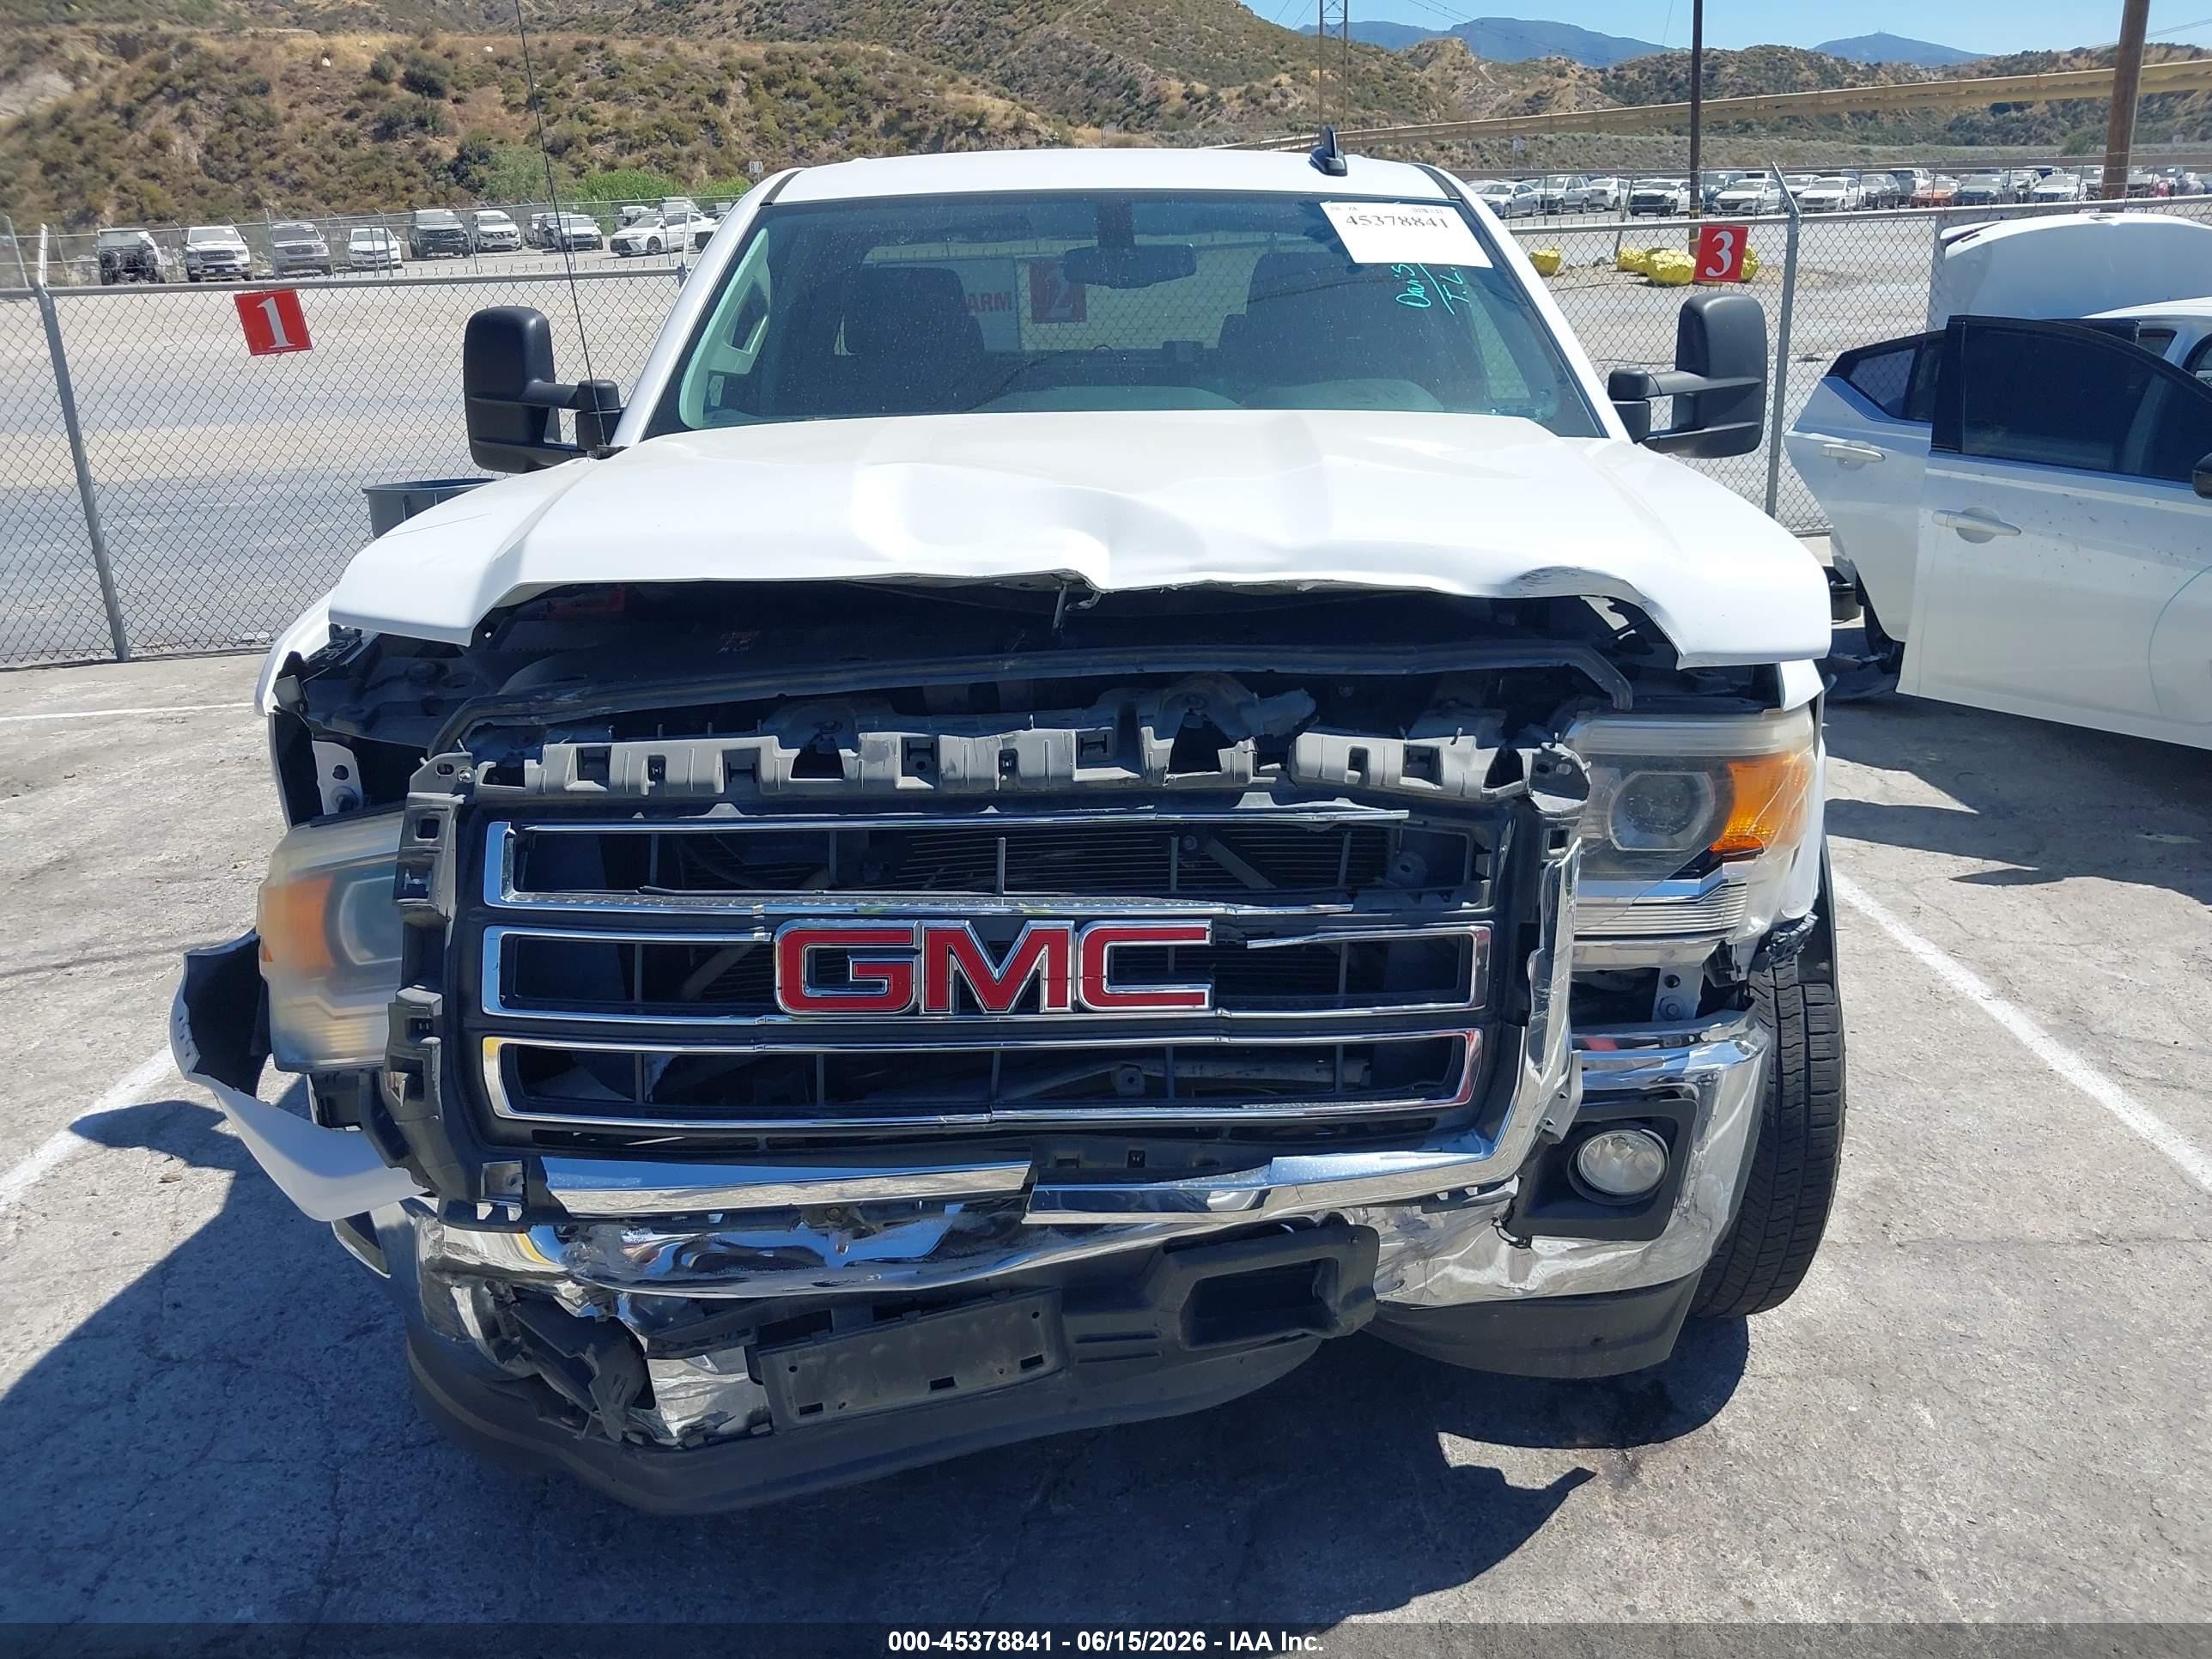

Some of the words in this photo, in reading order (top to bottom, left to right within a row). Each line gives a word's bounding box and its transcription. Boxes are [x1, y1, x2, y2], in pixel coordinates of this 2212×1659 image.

[1346, 216, 1449, 228] 45378841
[1705, 230, 1734, 277] 3
[1043, 264, 1073, 319] 2
[257, 296, 296, 349] 1
[774, 920, 1213, 1016] GMC
